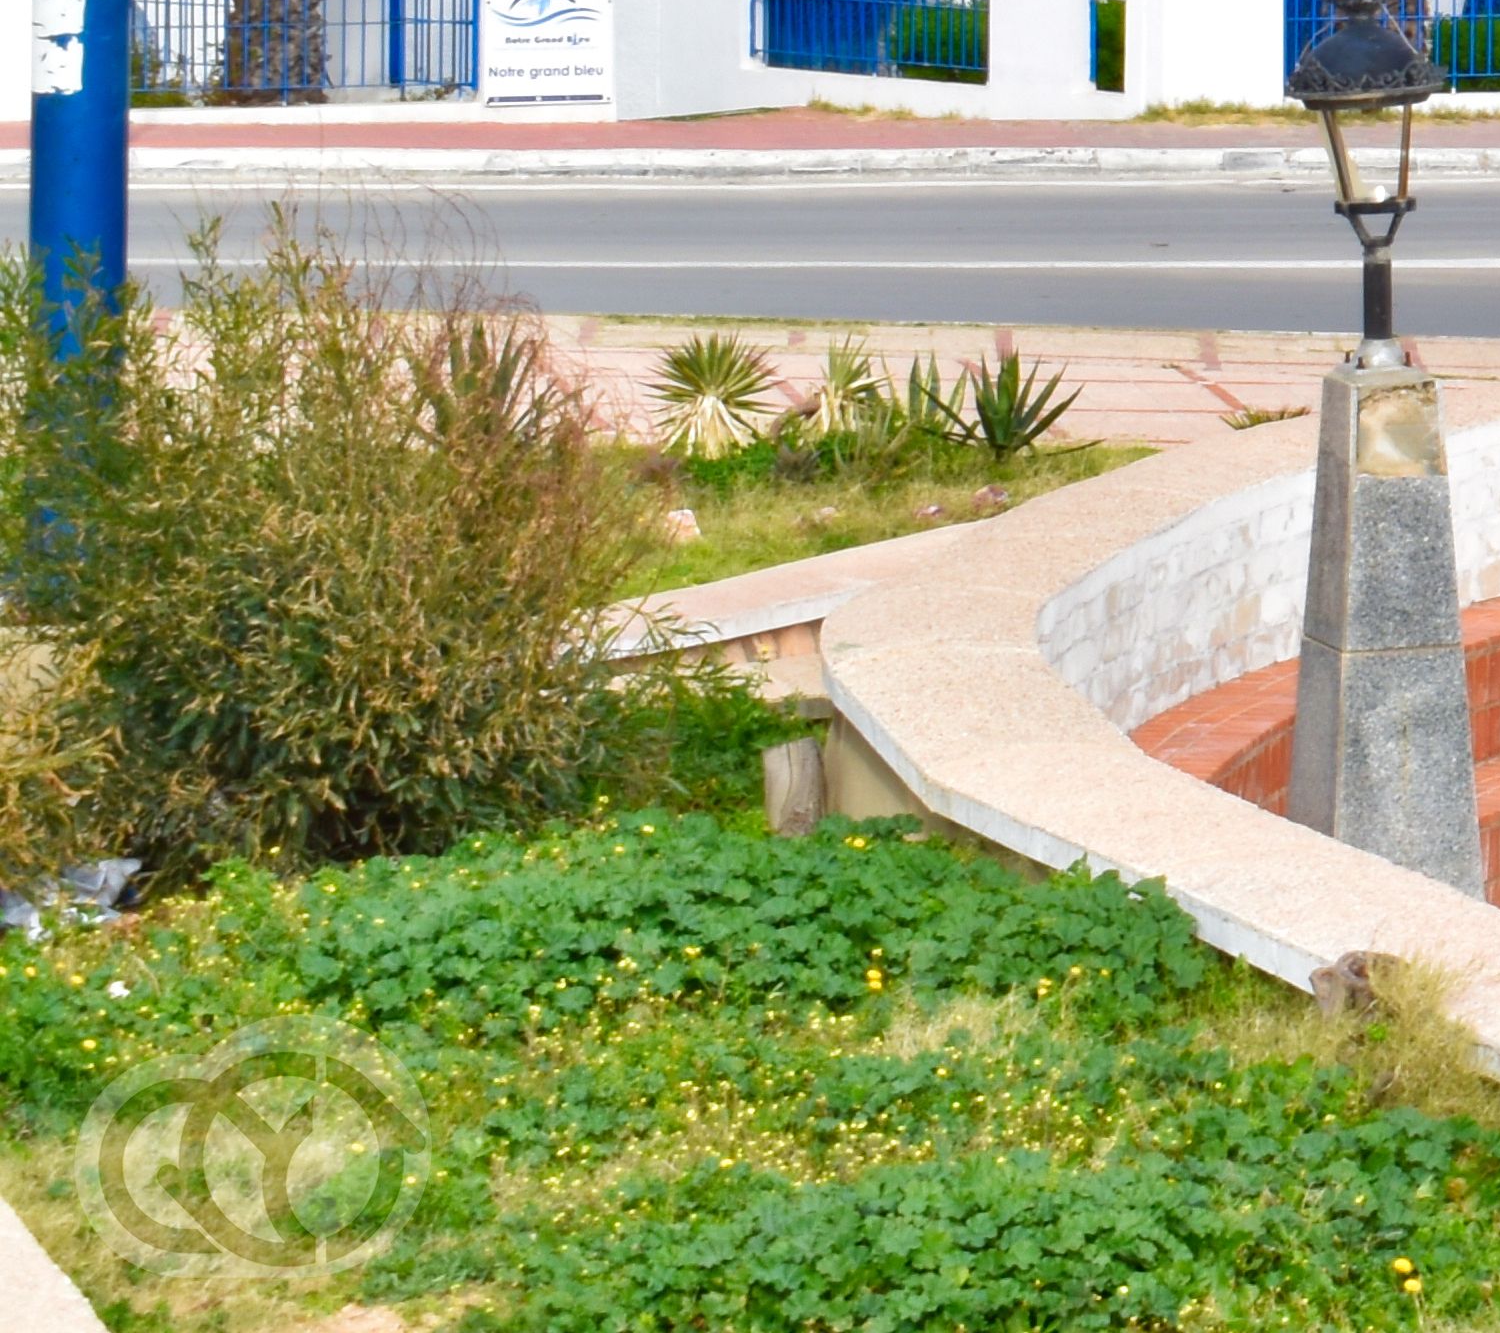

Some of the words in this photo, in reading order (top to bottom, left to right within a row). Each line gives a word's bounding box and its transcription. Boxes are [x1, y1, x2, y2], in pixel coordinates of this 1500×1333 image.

[488, 67, 525, 77] Notre
[529, 66, 570, 79] grand
[574, 65, 604, 76] bleu
